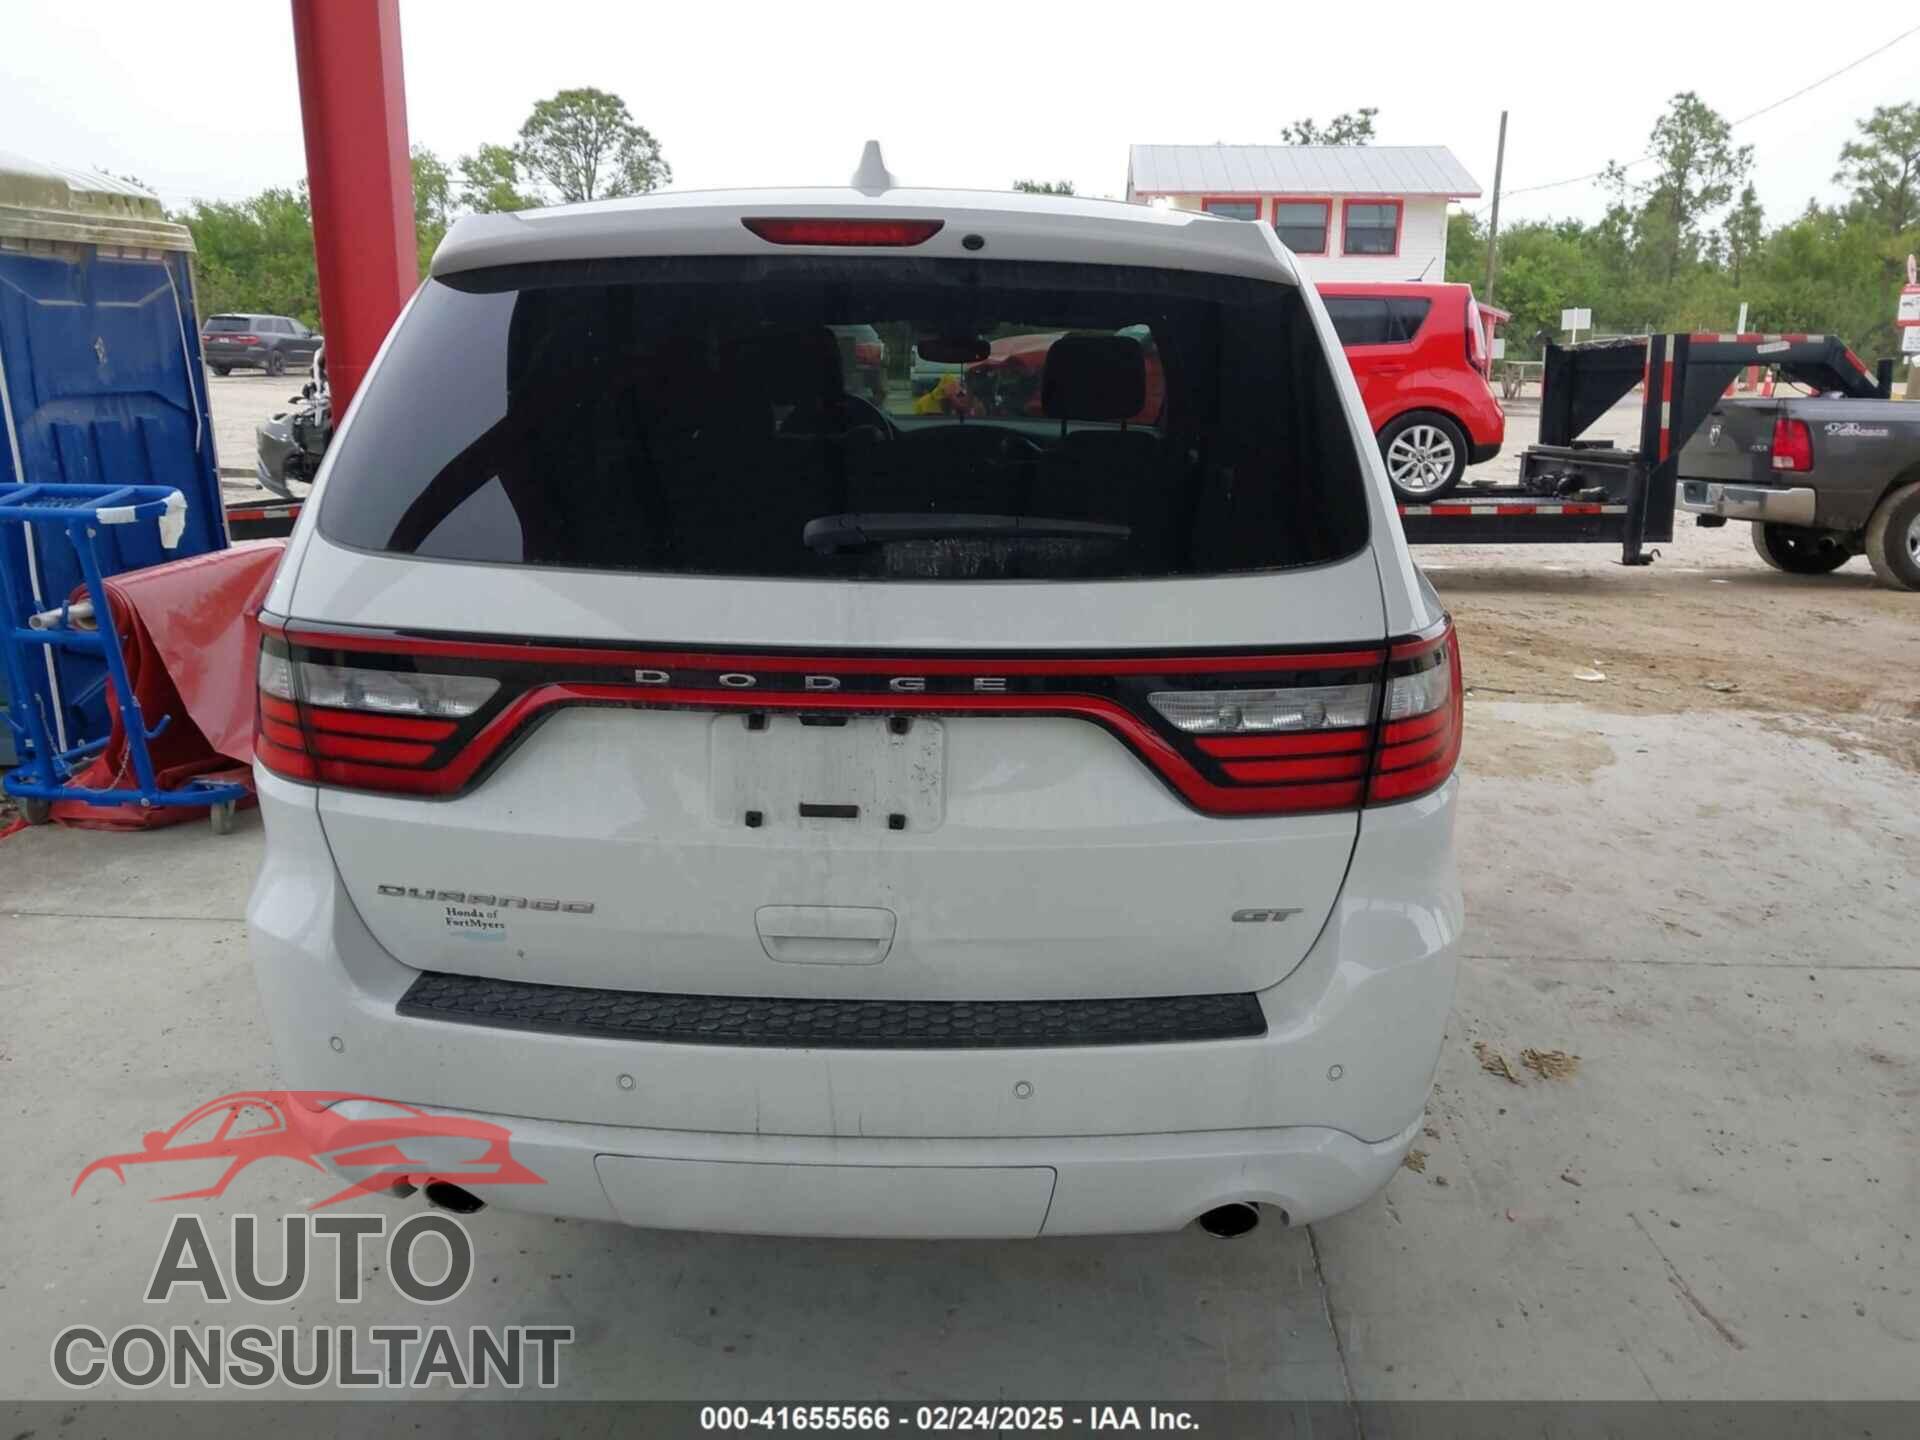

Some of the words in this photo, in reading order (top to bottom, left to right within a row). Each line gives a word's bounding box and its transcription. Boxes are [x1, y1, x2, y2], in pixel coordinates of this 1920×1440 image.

[634, 669, 1008, 692] DODGE
[376, 883, 595, 914] DURANGO
[446, 907, 485, 918] Honda
[487, 909, 499, 919] of
[1231, 907, 1304, 923] GT
